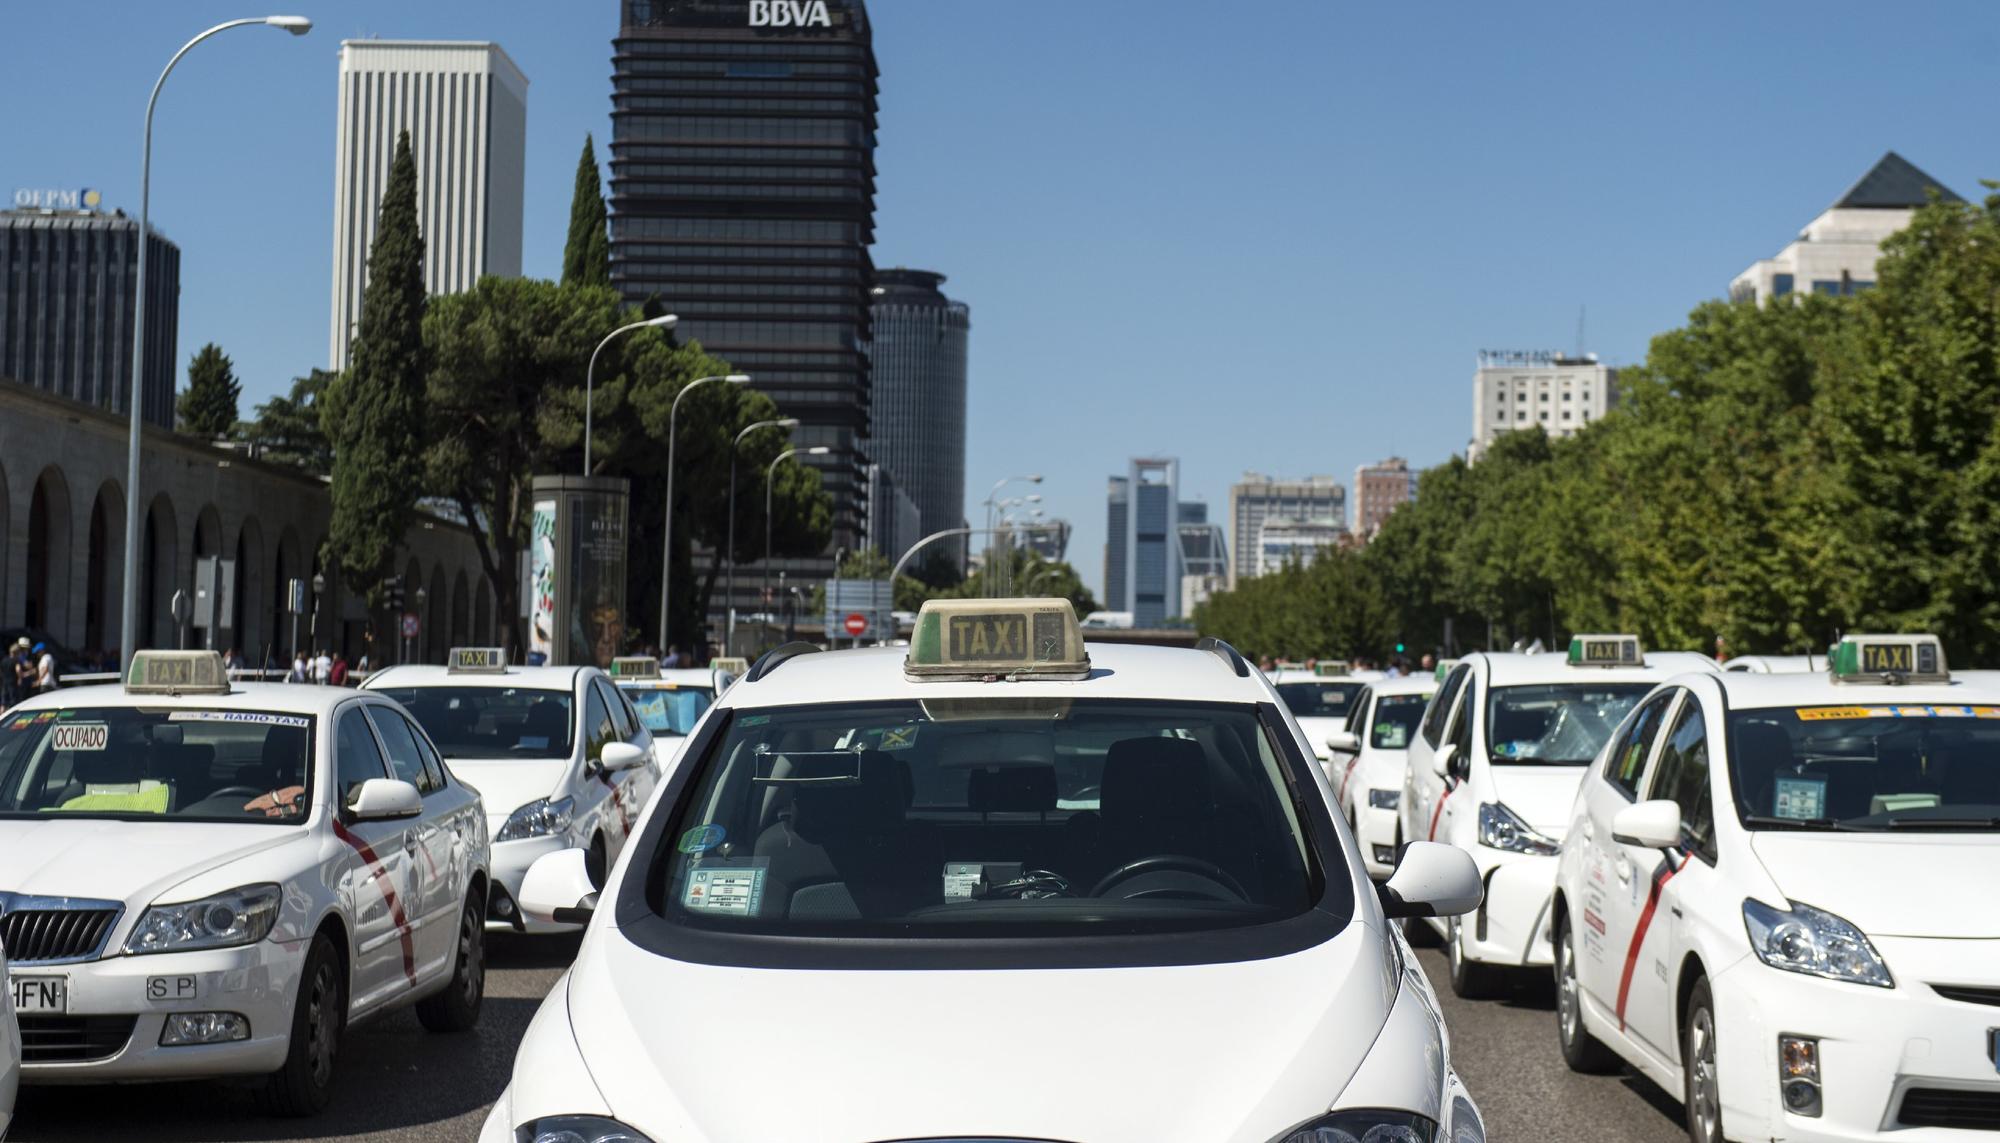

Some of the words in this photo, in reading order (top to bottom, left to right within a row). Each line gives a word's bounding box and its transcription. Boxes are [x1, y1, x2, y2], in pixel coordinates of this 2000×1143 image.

[748, 0, 832, 27] BBVA
[953, 620, 1024, 655] TAXI
[461, 651, 487, 665] TAXI
[1588, 643, 1618, 659] TAXI
[1865, 647, 1911, 671] TAXI
[152, 661, 190, 683] TAXI
[223, 712, 306, 726] RADIO-TAXI
[55, 727, 105, 748] OCUPADO
